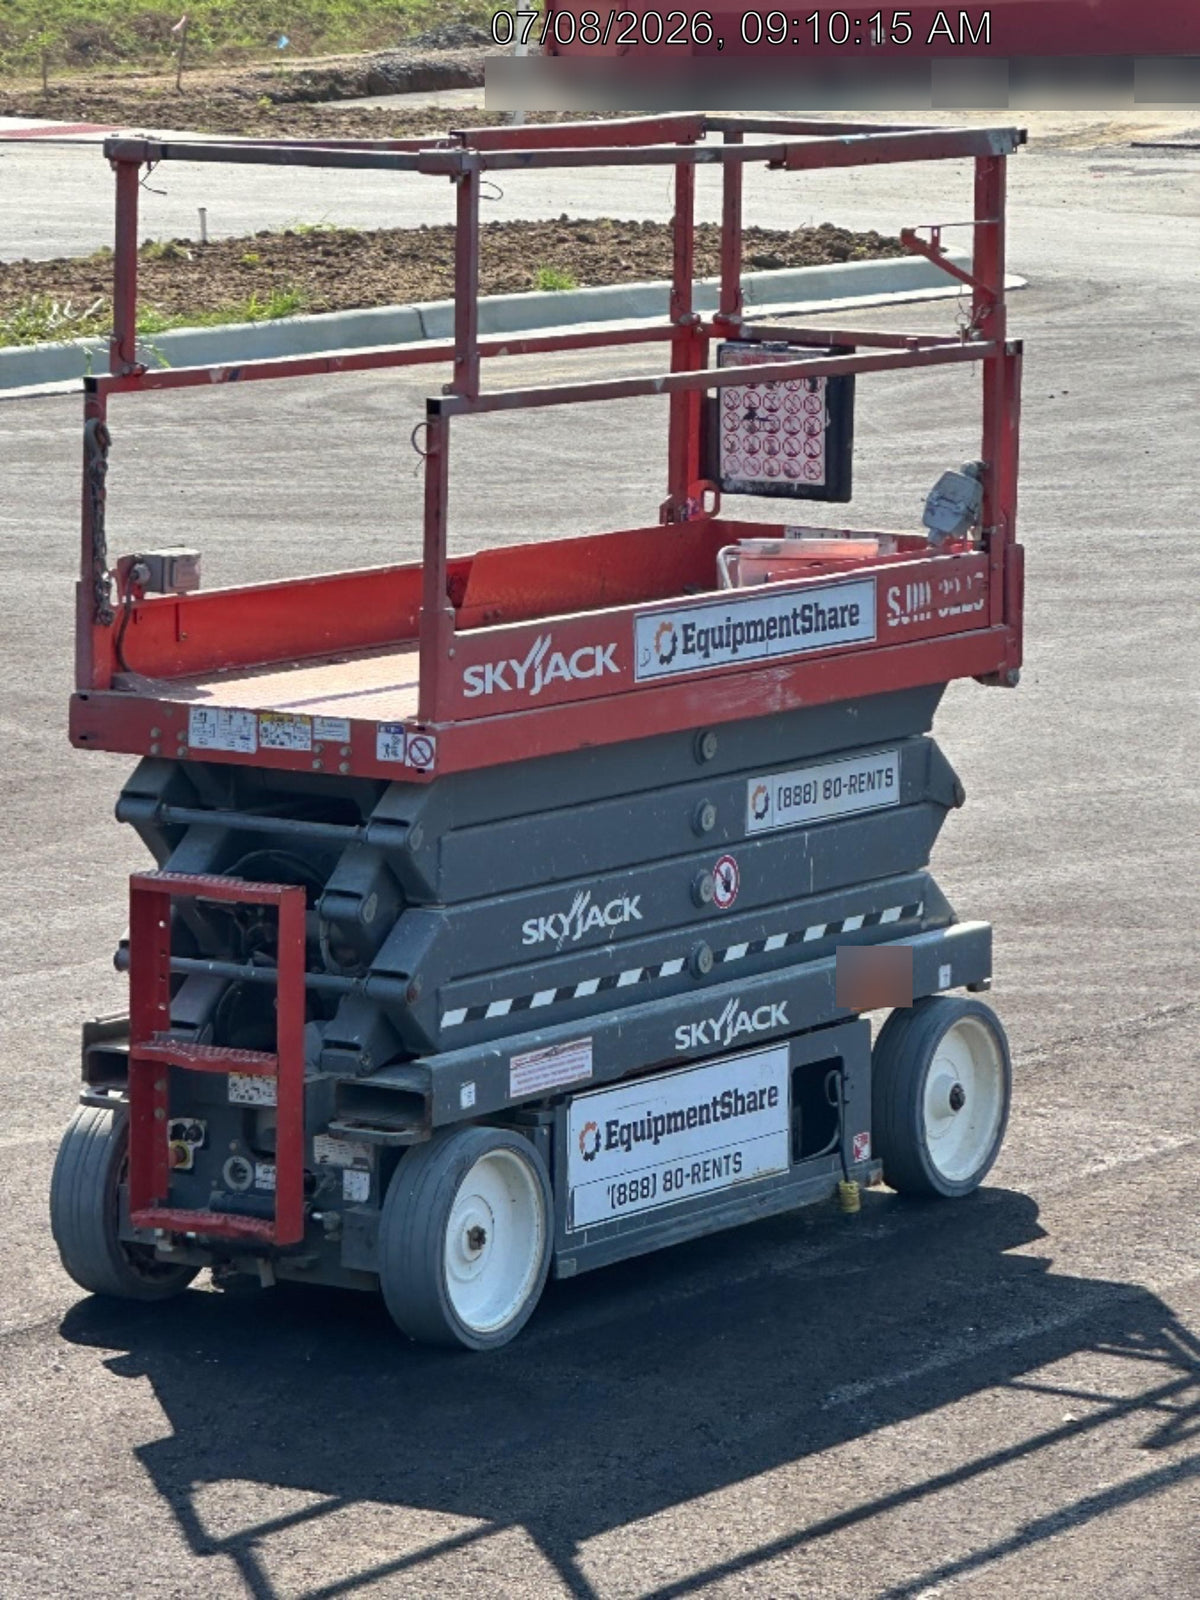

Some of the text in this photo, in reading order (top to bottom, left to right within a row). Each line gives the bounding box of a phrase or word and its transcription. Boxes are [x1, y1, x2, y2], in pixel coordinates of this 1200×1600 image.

[682, 602, 860, 658] EquipmentShare
[463, 634, 621, 697] SKYJACK
[777, 767, 894, 811] (888) 80-RENTS
[521, 890, 643, 945] SKYJACK
[674, 997, 790, 1050] SKYJACK
[604, 1085, 779, 1152] EquipmentShare
[662, 1151, 743, 1193] 80-RENTS
